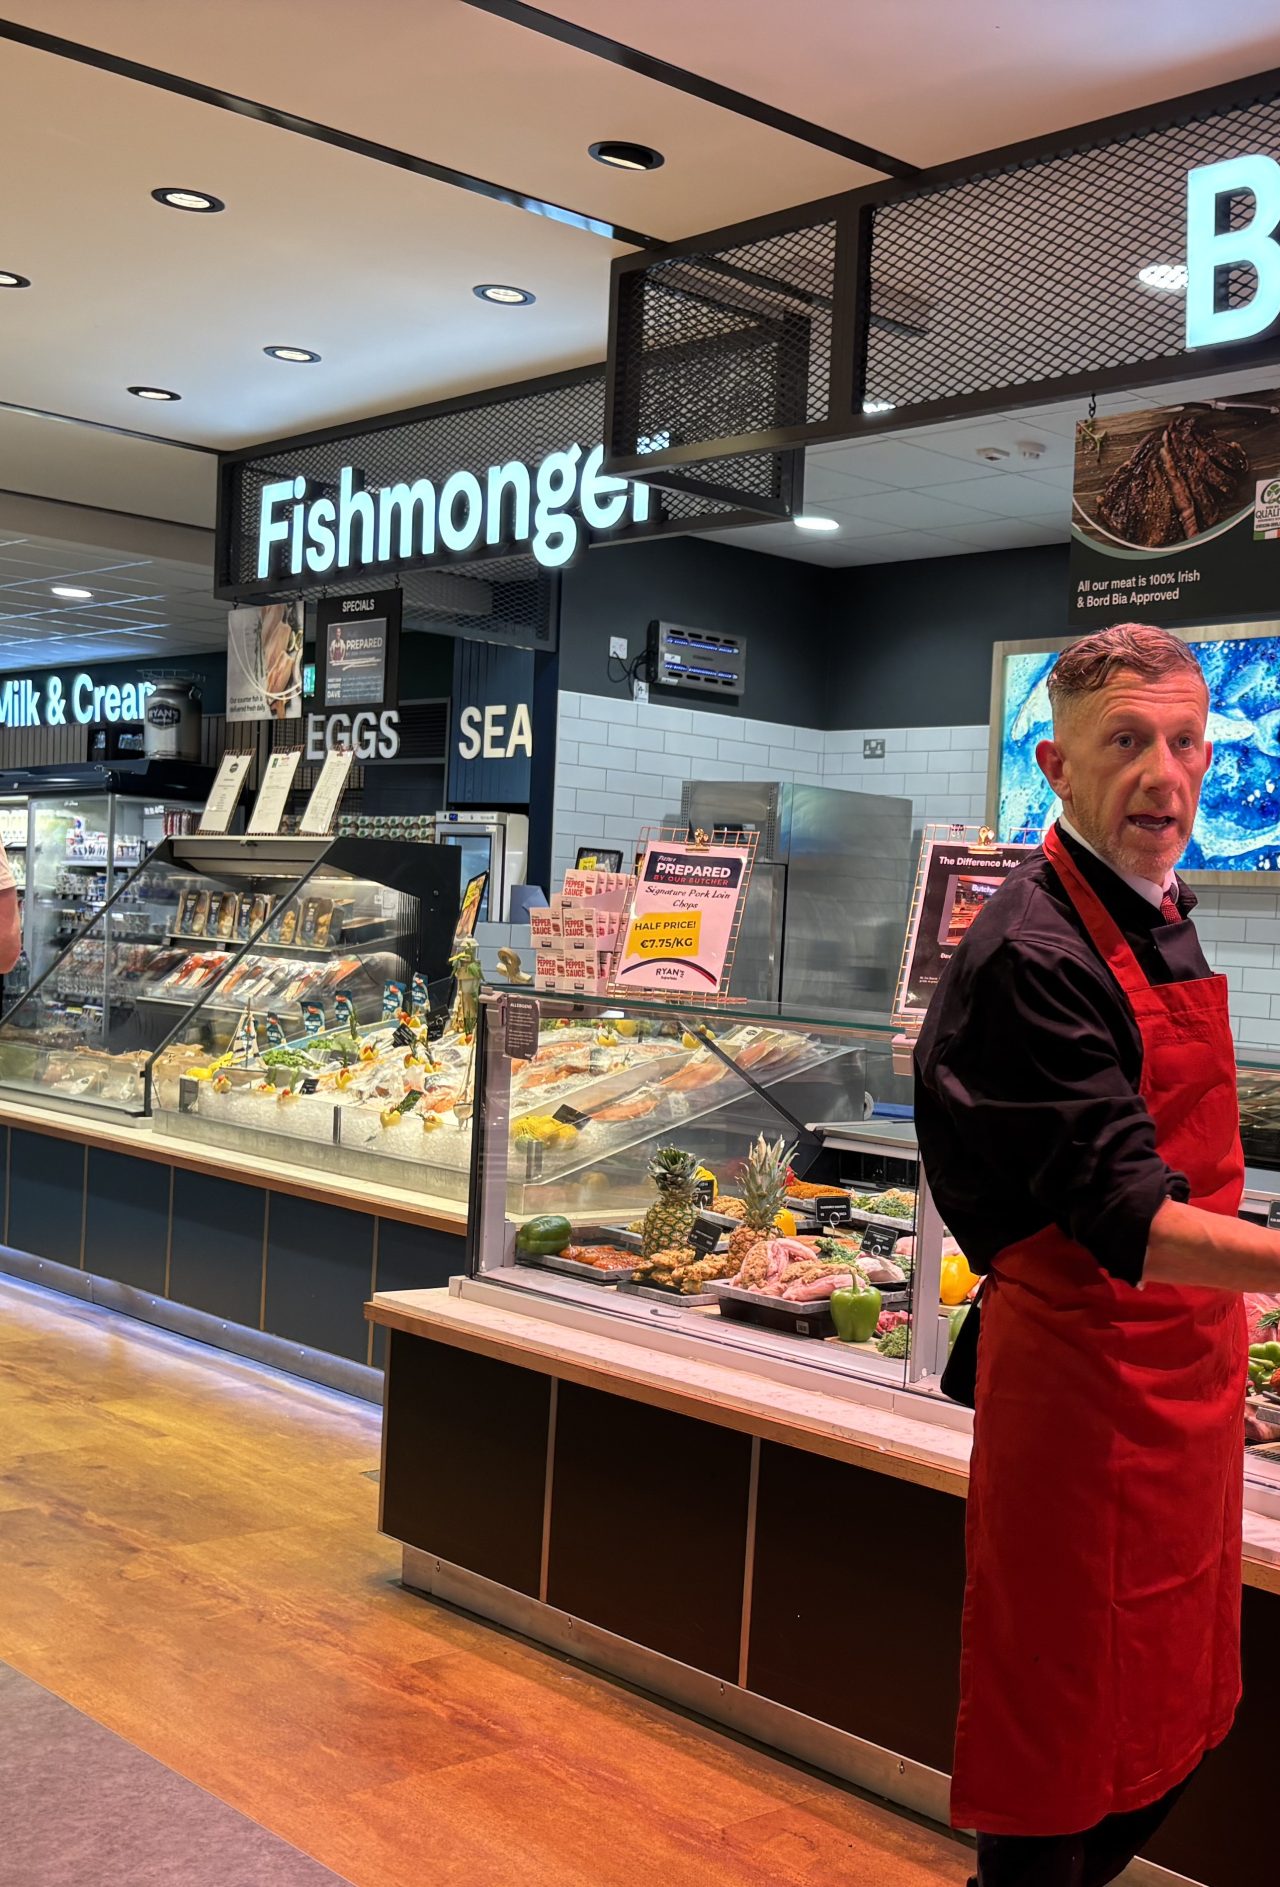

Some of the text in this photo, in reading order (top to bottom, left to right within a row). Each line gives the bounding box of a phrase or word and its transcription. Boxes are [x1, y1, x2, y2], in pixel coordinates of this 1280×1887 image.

[257, 432, 668, 567] Fishmonger
[1077, 569, 1200, 593] All our meat is 100% Irish
[1077, 588, 1179, 608] & Bord Bia Approved
[342, 599, 375, 613] SPECIALS
[346, 637, 382, 649] PREPARED
[46, 676, 66, 725] &
[308, 710, 399, 760] EGGS
[458, 704, 532, 760] SEA
[939, 856, 955, 865] The
[956, 857, 1000, 867] Difference
[656, 862, 731, 878] PREPARED
[565, 880, 584, 888] PEPPER
[689, 878, 728, 886] BUTCHER
[564, 888, 584, 896] SAUCE
[645, 885, 730, 899] Signature Pork Loin
[672, 900, 698, 910] Chops
[565, 920, 584, 928] PEPPER
[635, 921, 696, 930] HALF PRICE!
[532, 927, 551, 935] SAUCE
[565, 928, 584, 936] SAUCE
[640, 938, 693, 949] €7.75/KG
[565, 961, 585, 969] PEPPER
[537, 967, 556, 975] SAUCE
[565, 969, 585, 977] SAUCE
